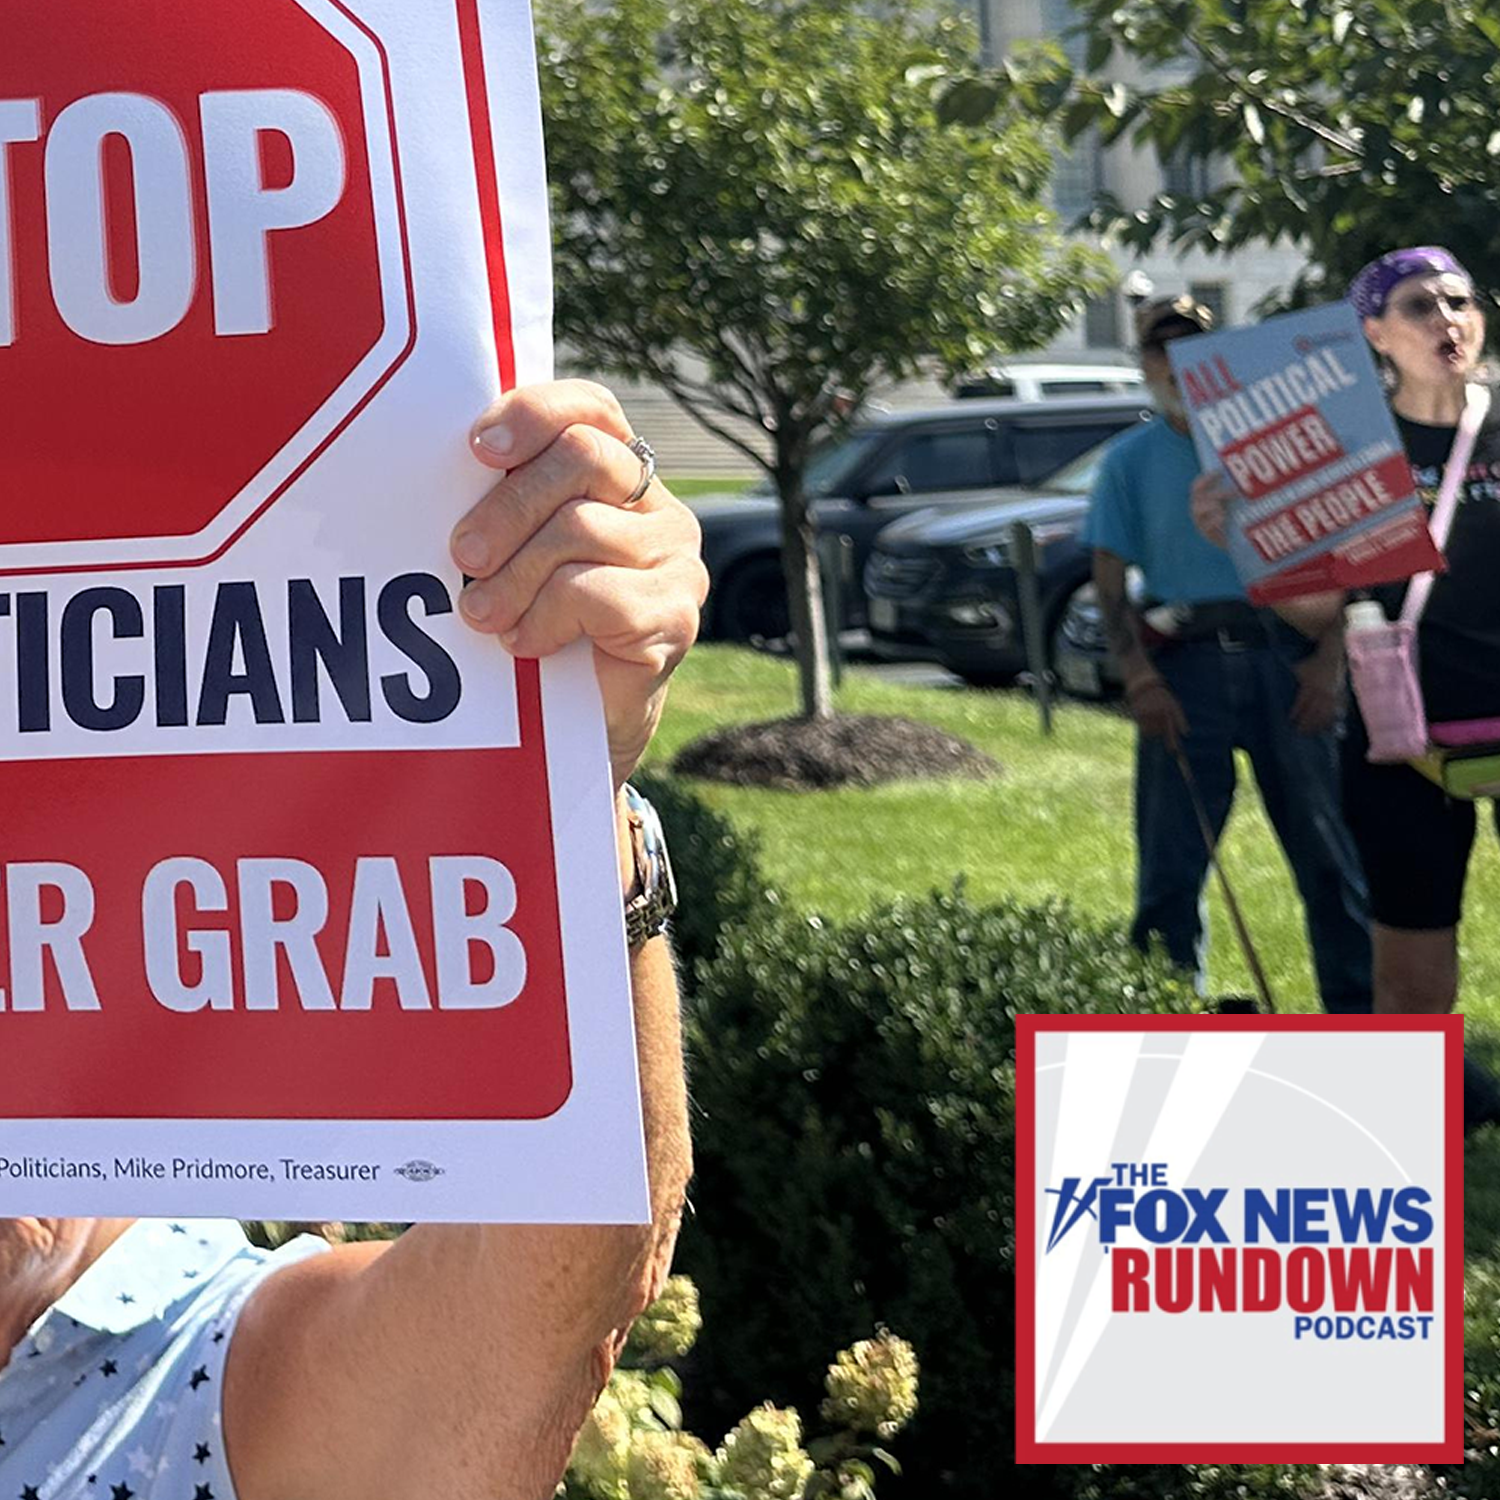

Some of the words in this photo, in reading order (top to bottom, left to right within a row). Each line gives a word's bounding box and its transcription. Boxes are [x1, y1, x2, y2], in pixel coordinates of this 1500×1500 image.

[1182, 353, 1242, 409] ALL
[1199, 346, 1357, 449] POLITICAL
[1224, 414, 1338, 494] POWER
[1252, 513, 1309, 562] THE
[1294, 469, 1393, 542] PEOPLE
[142, 855, 528, 1014] GRAB
[114, 1157, 165, 1179] Mike
[172, 1157, 275, 1183] Pridmore,
[279, 1158, 381, 1181] Treasurer
